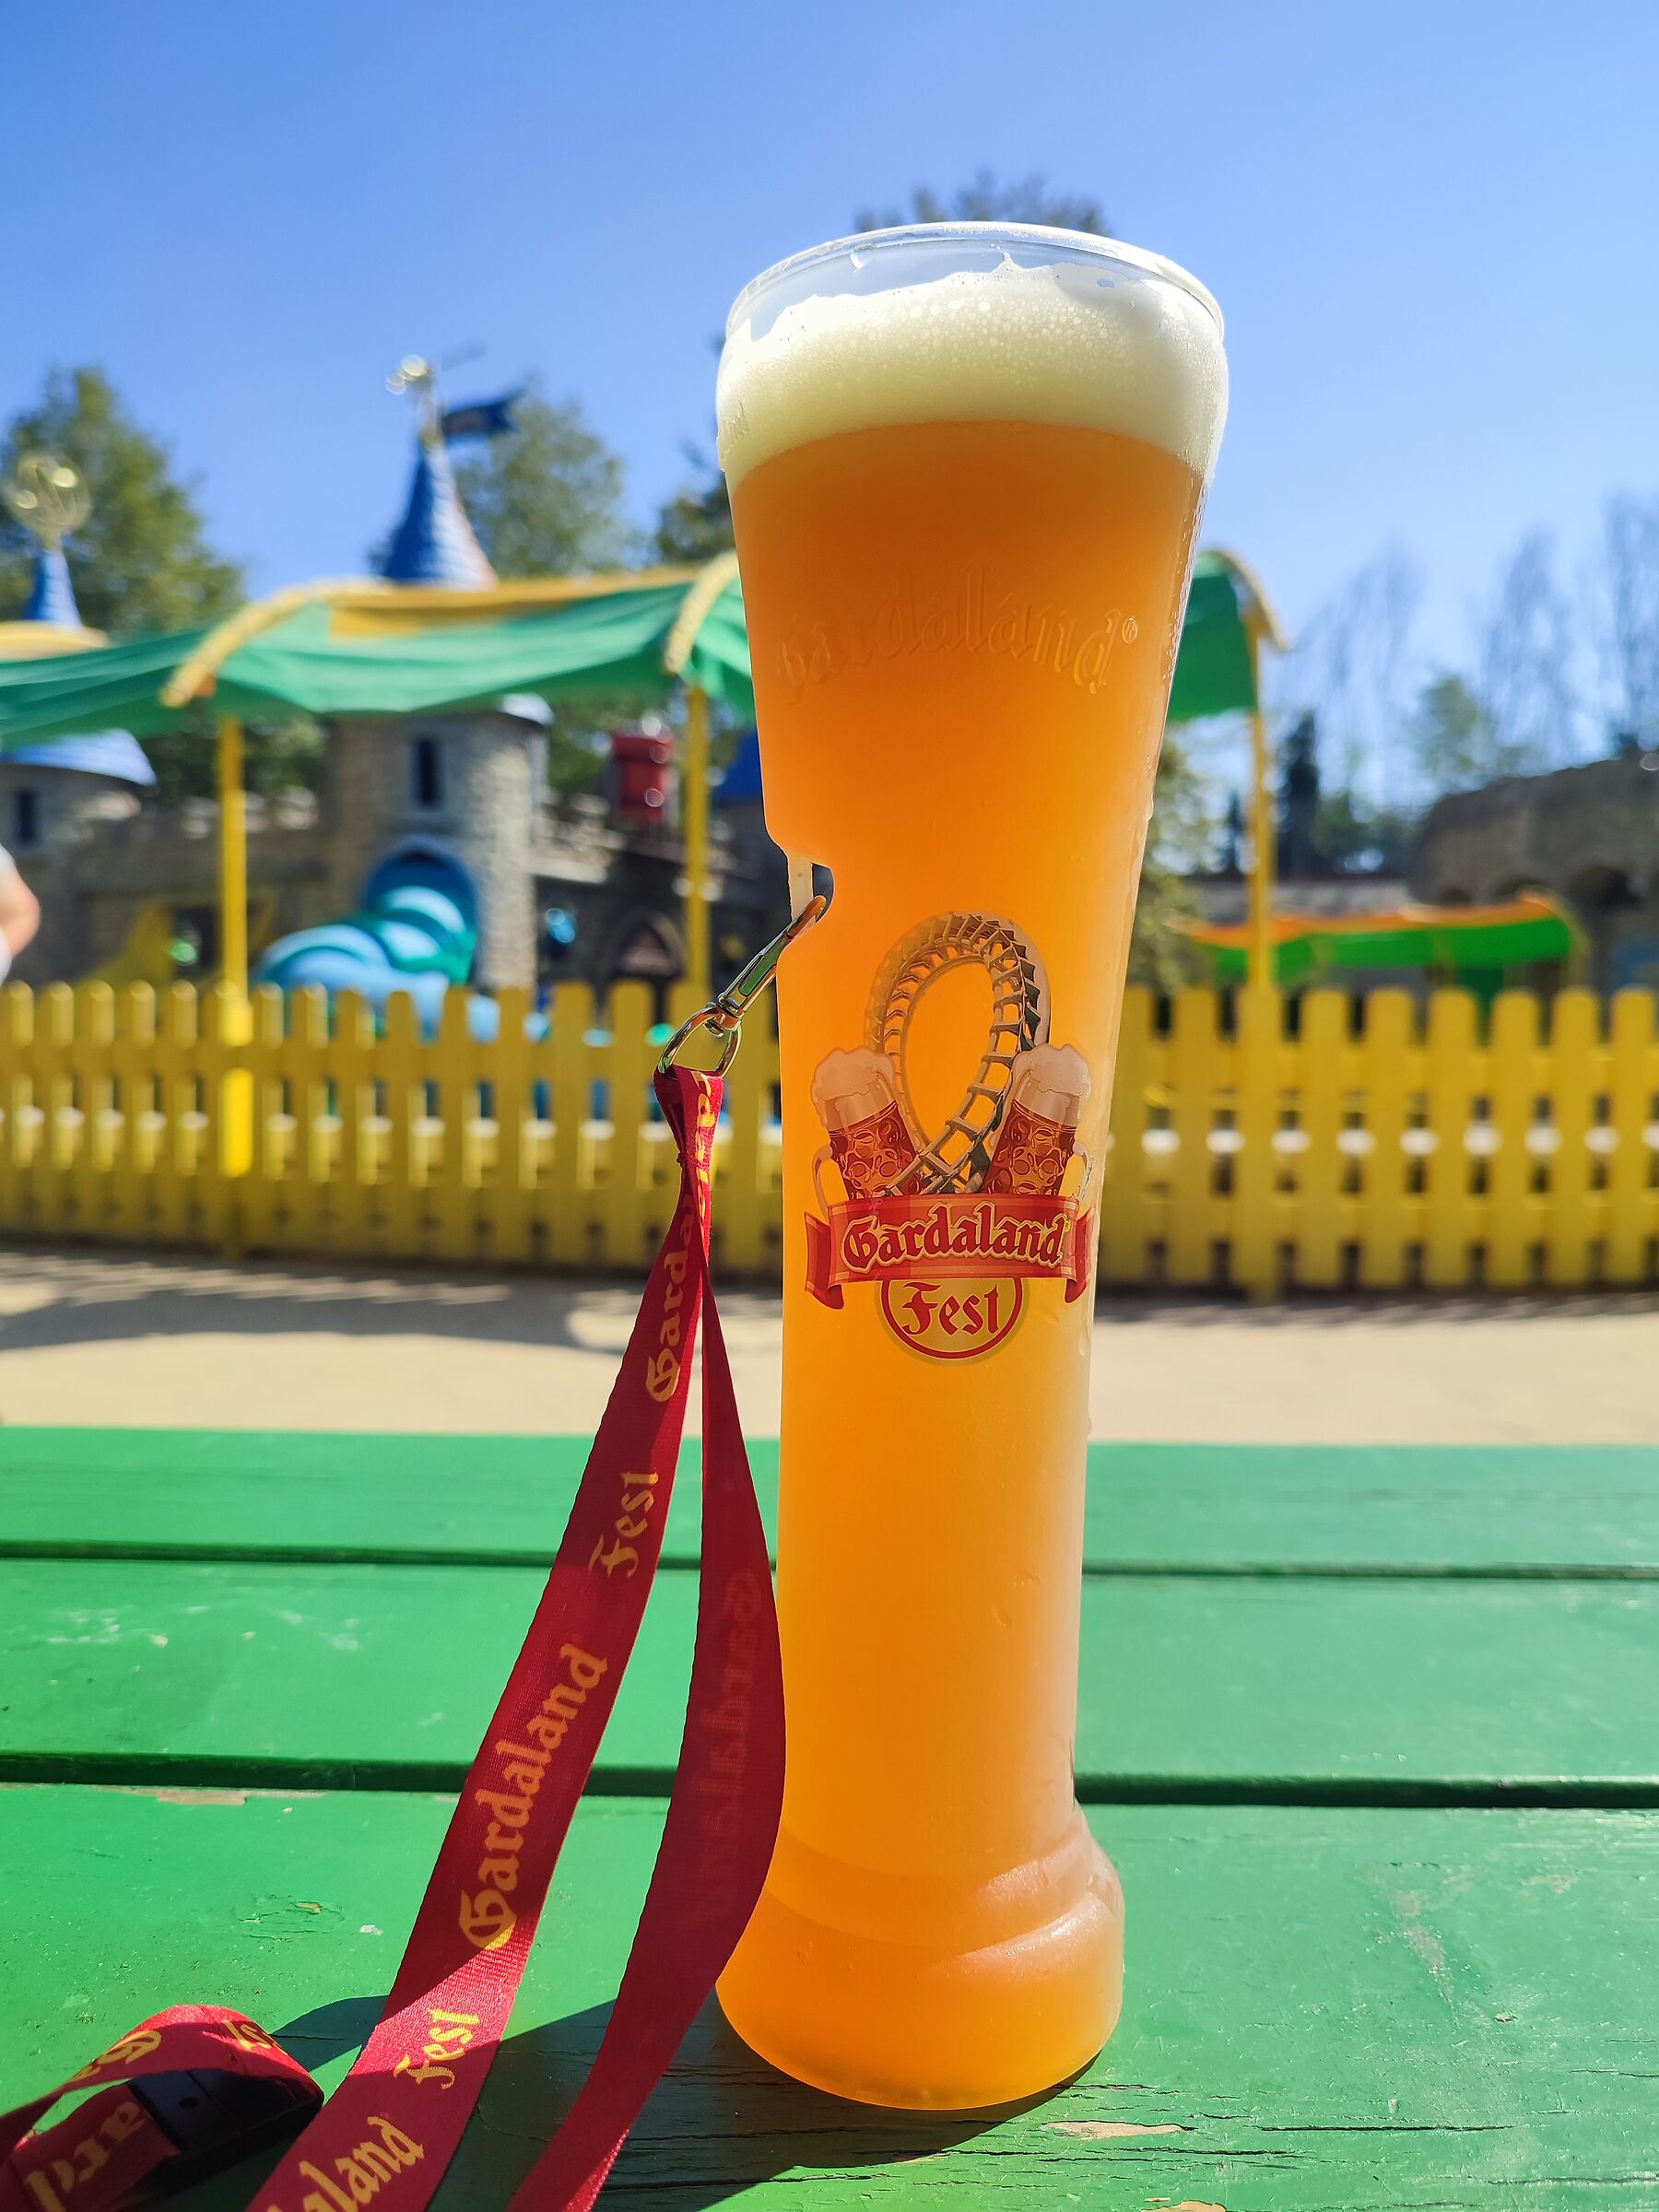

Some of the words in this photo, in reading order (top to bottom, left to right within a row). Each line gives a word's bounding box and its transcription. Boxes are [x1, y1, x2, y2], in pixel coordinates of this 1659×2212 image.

[841, 1200, 1072, 1273] Gardaland
[902, 1281, 999, 1335] Fest
[459, 1642, 608, 1950] Gardaland
[588, 1469, 660, 1577] Fest
[394, 2007, 479, 2090] Fest
